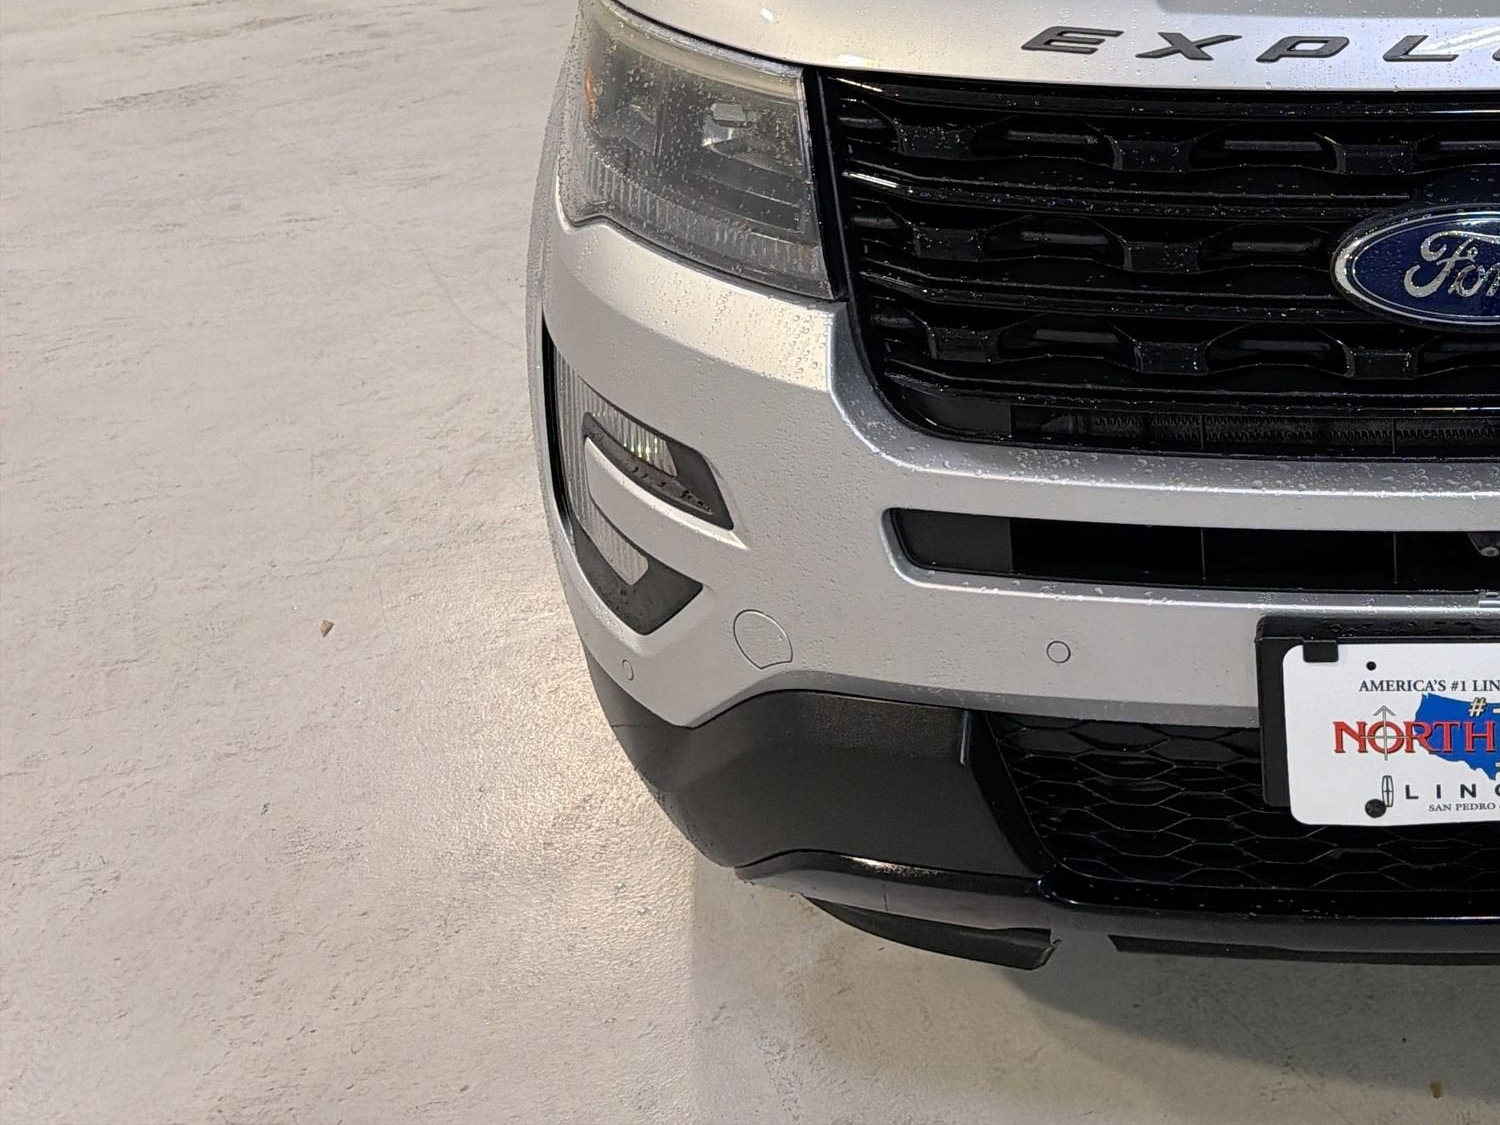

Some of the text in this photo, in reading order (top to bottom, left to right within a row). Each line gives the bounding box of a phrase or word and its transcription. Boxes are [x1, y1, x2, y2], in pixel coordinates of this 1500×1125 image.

[1358, 679, 1446, 692] AMERICA'S
[1450, 679, 1466, 692] #1
[1333, 720, 1496, 754] NORTH
[1428, 803, 1452, 812] SAN
[1455, 802, 1496, 811] PEDRO
